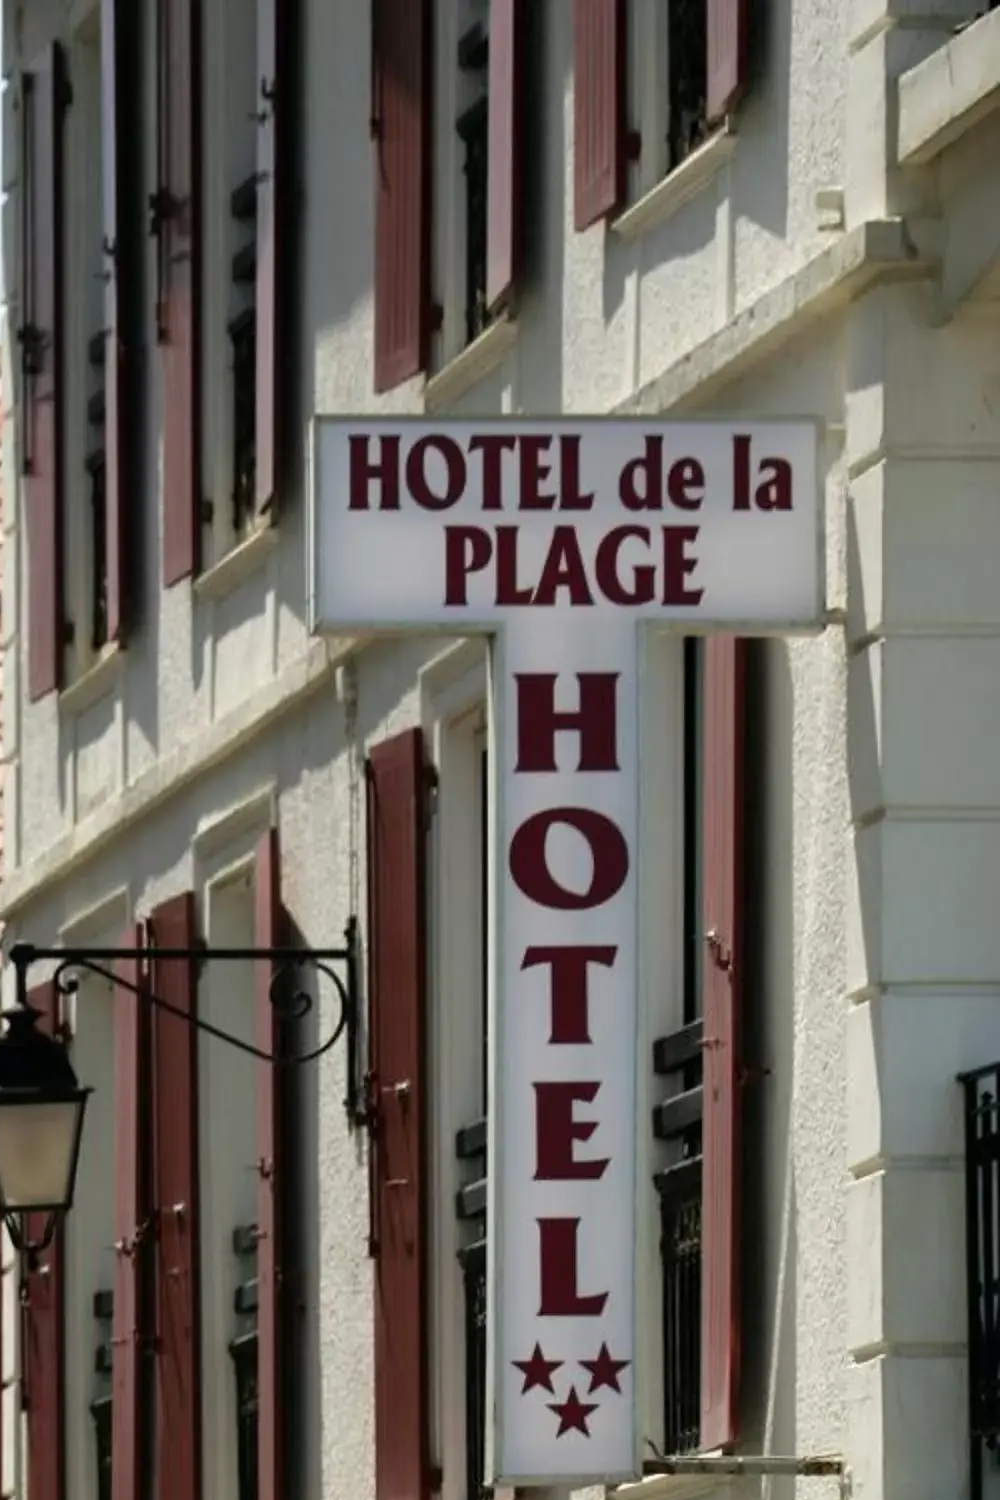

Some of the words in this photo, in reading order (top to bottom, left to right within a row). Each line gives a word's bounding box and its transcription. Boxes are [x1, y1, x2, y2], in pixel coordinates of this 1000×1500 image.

[347, 434, 594, 511] HOTEL
[618, 434, 705, 511] de
[733, 434, 793, 511] la
[444, 524, 705, 606] PLAGE
[509, 672, 629, 1317] HOTEL
